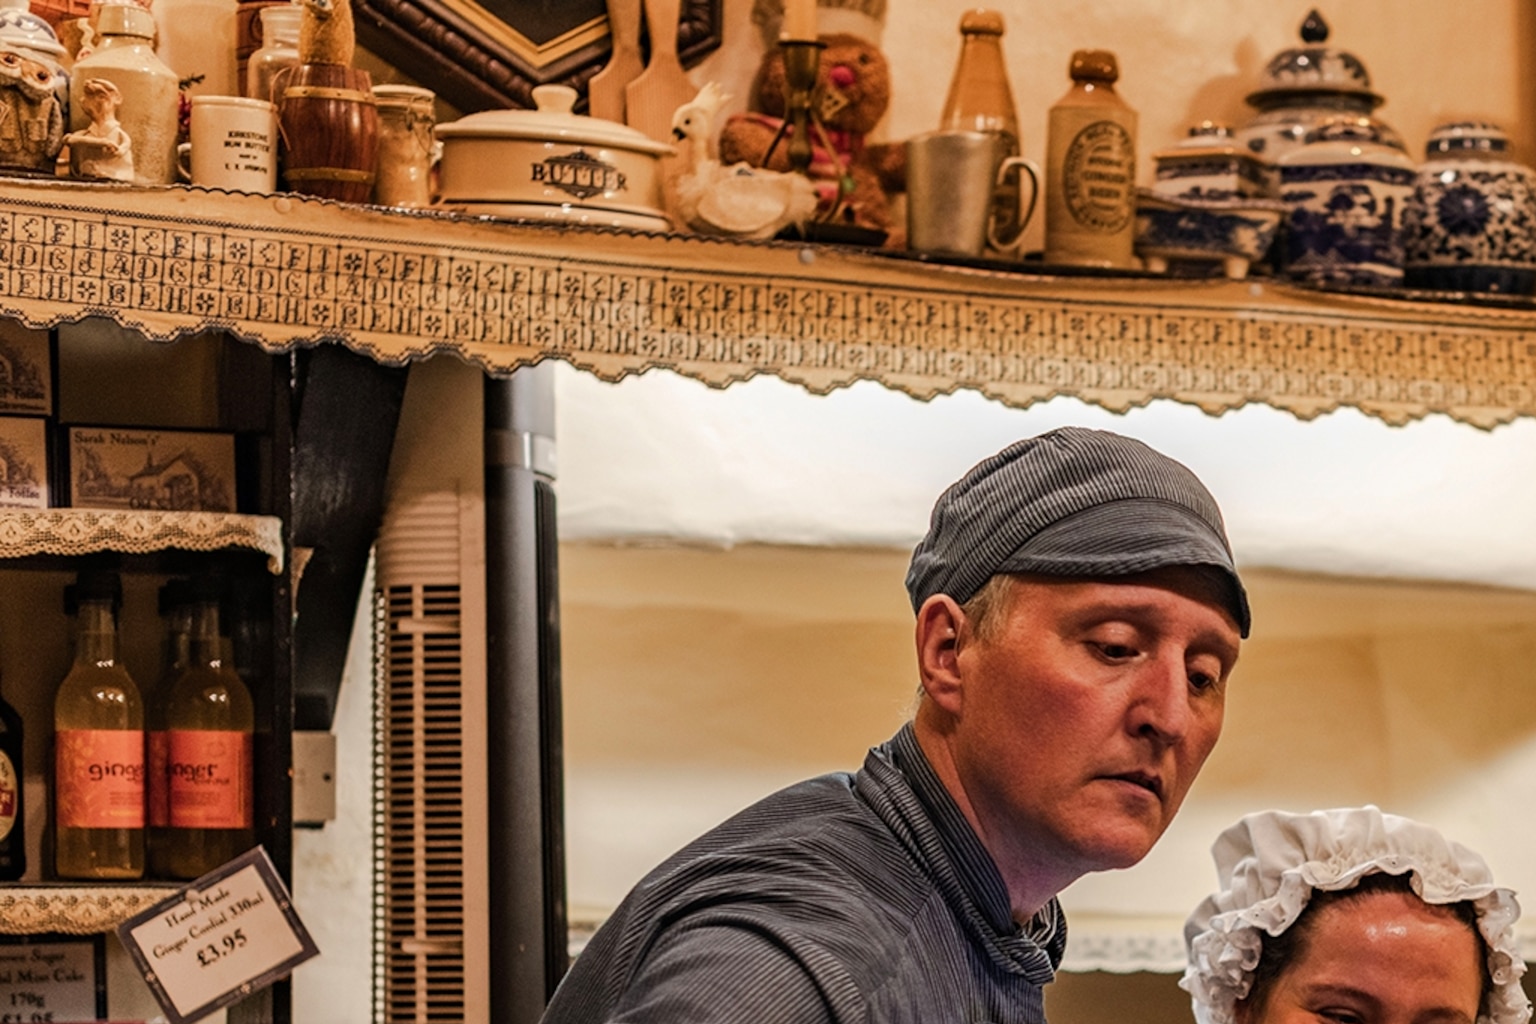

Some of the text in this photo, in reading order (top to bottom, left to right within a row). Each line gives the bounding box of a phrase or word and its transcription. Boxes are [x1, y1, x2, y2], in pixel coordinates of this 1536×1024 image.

[531, 162, 627, 192] BUTTER
[74, 431, 105, 445] Sarah
[164, 887, 231, 928] Hand Made
[152, 937, 188, 960] Ginger
[188, 912, 229, 939] Cordial
[196, 927, 248, 968] £3.95
